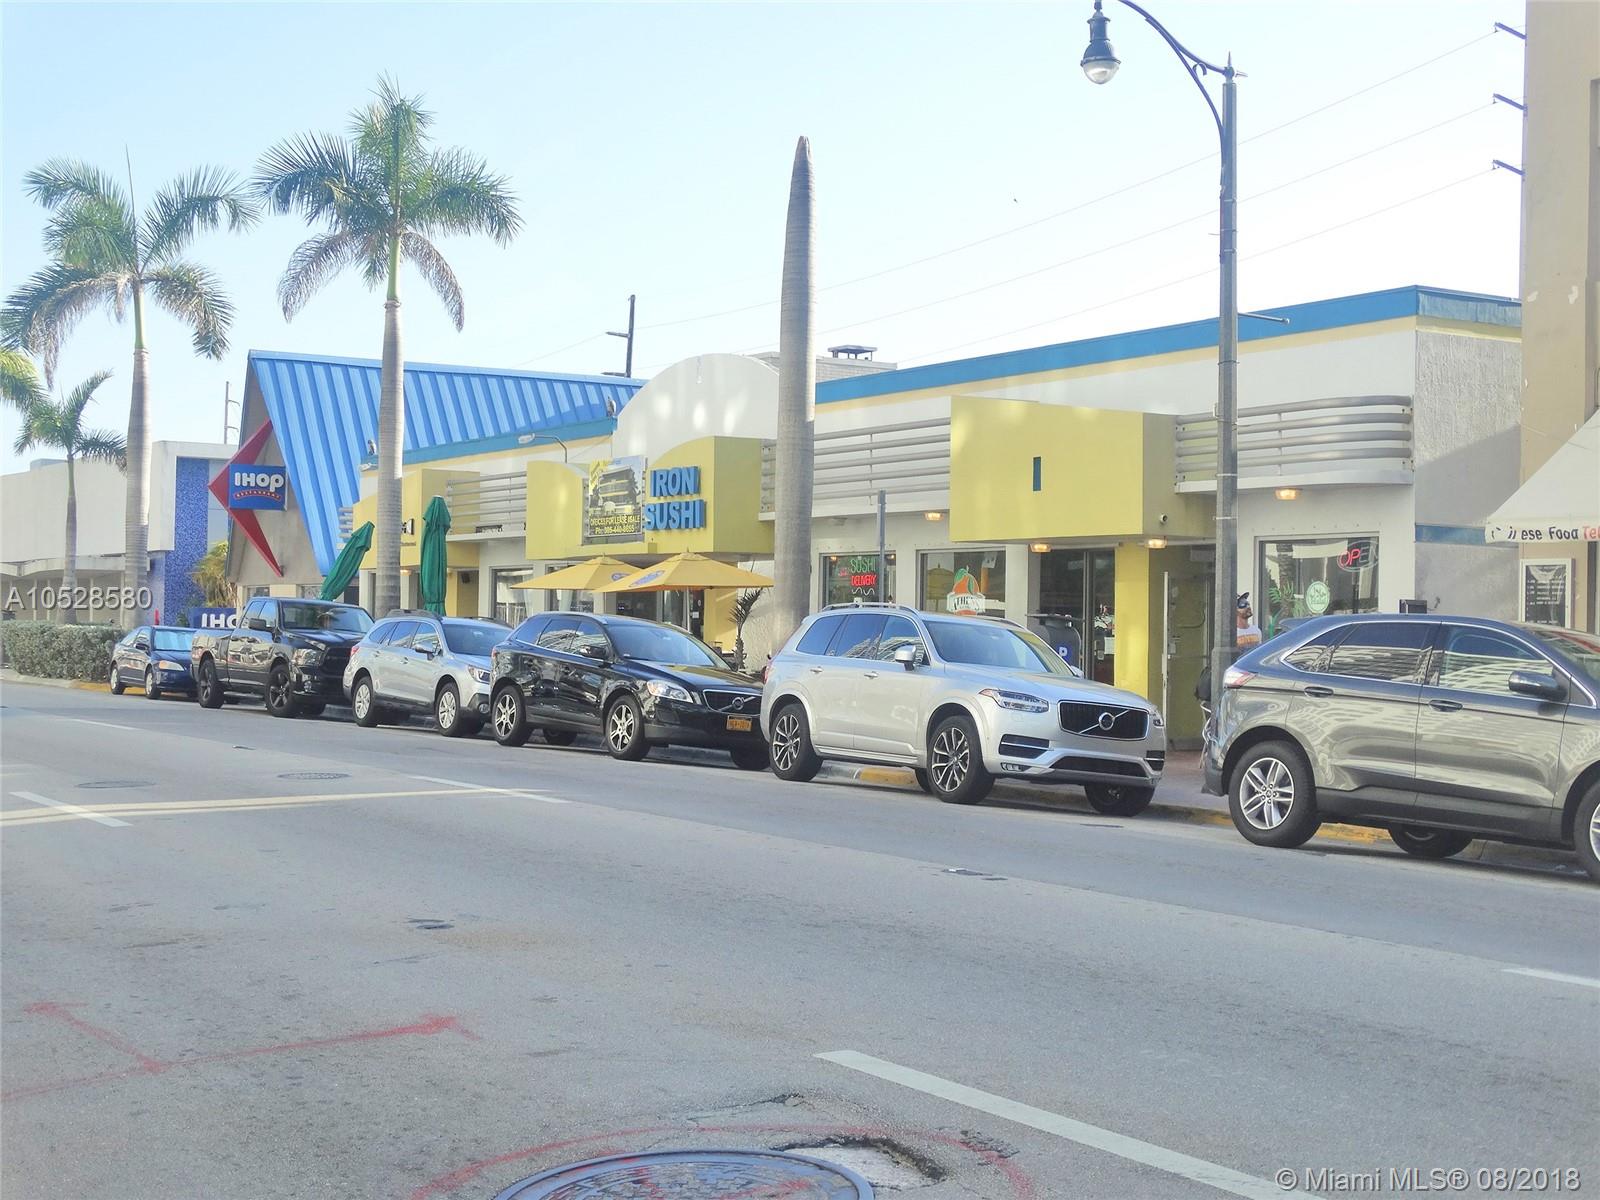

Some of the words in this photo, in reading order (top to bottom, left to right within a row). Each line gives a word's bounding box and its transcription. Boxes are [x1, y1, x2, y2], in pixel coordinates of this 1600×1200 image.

[234, 472, 284, 492] IHOP
[650, 466, 701, 497] IRON
[644, 499, 706, 530] SUSHI
[850, 558, 876, 573] SUSHI
[1339, 545, 1378, 567] OPEN
[850, 574, 877, 587] DELIVERY
